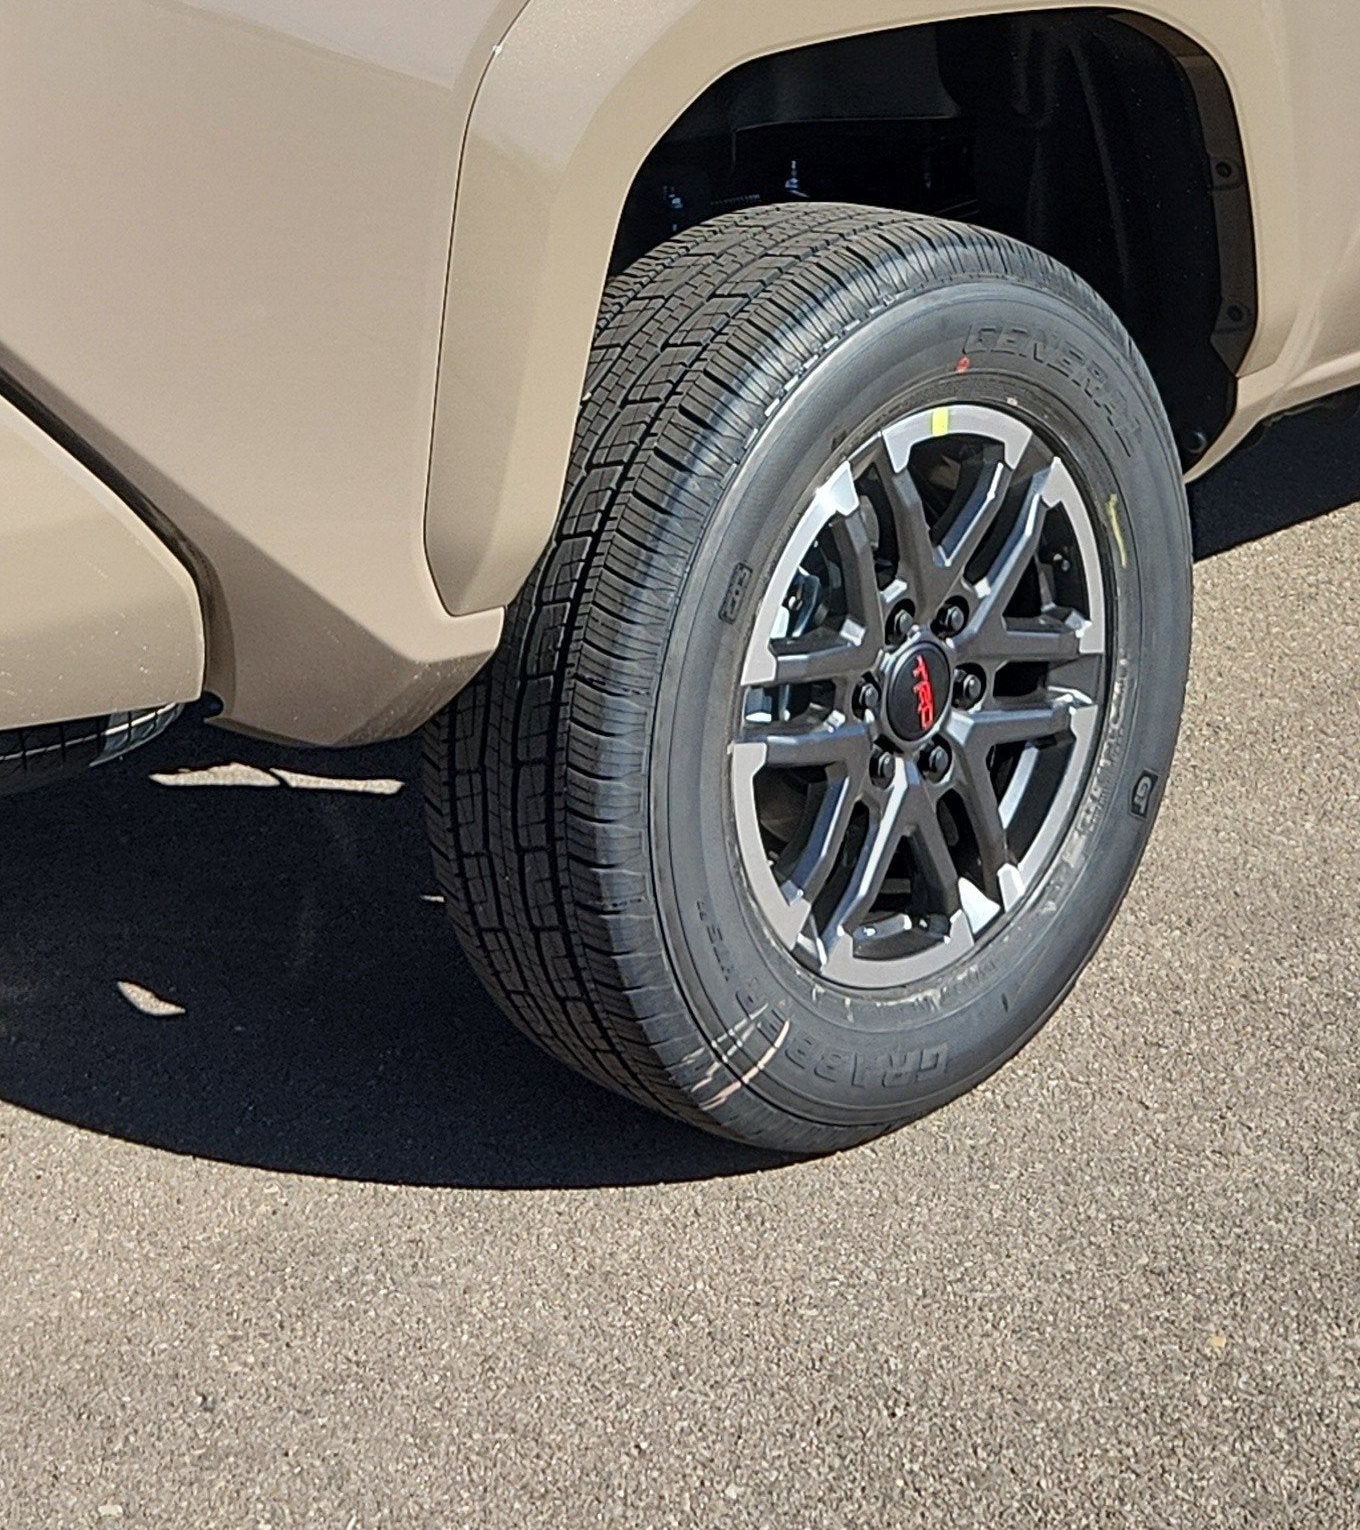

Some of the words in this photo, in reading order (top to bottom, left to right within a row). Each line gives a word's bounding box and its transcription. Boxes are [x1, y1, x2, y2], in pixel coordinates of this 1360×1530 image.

[962, 324, 1141, 458] GENERAL
[912, 655, 935, 731] TRD
[1131, 775, 1152, 815] GT
